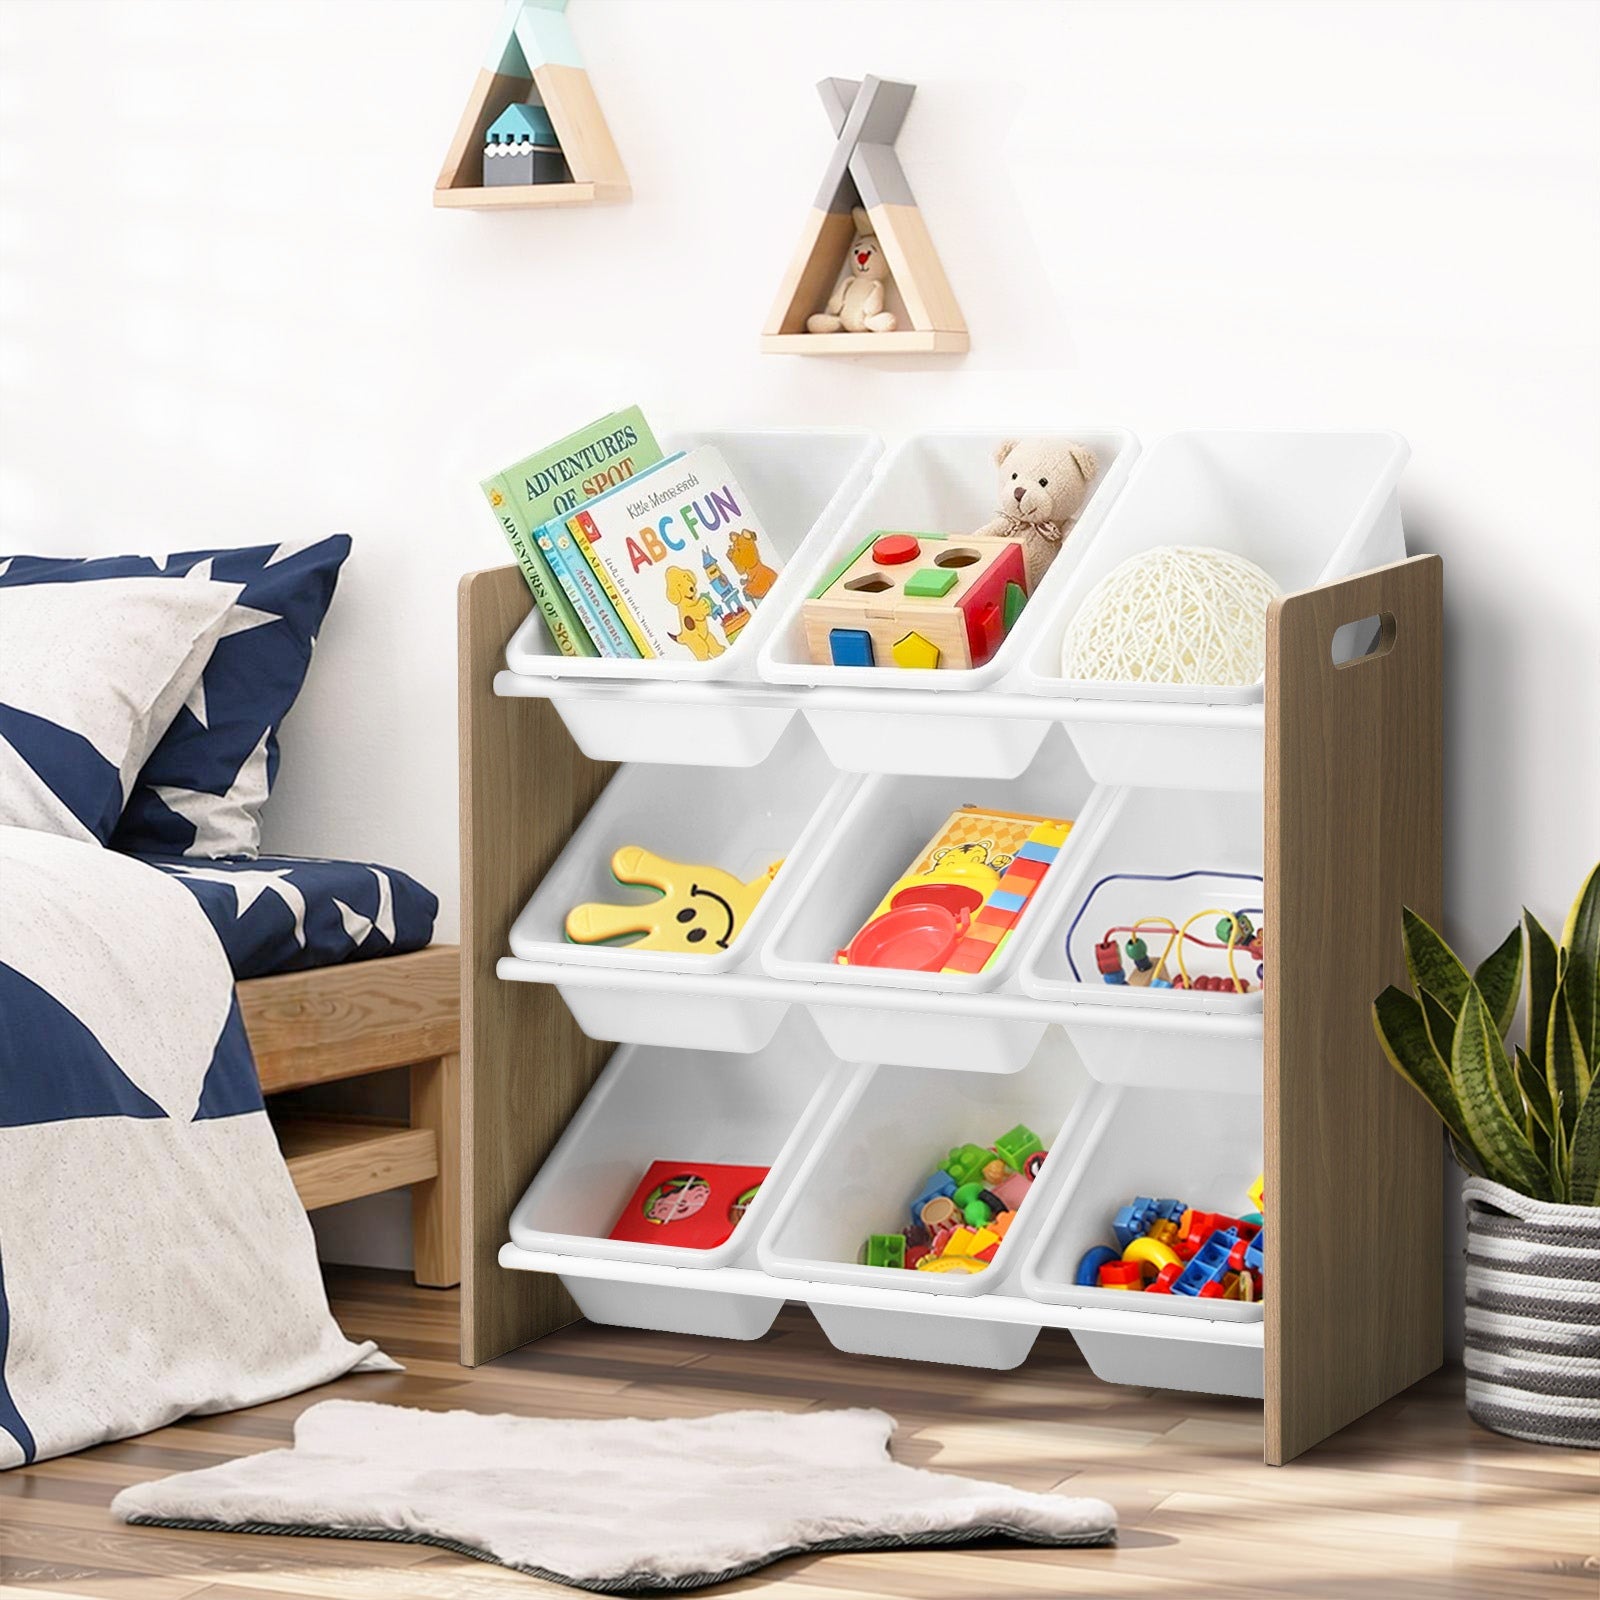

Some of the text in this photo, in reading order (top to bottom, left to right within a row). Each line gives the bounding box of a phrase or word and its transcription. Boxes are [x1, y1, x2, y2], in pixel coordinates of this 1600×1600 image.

[524, 425, 638, 501] ADVENTURES
[553, 488, 578, 516] OF
[582, 456, 635, 497] SPOT
[502, 516, 548, 598] ADVENTURES
[544, 601, 559, 619] OF
[625, 516, 686, 574] ABC
[679, 485, 742, 541] FUN
